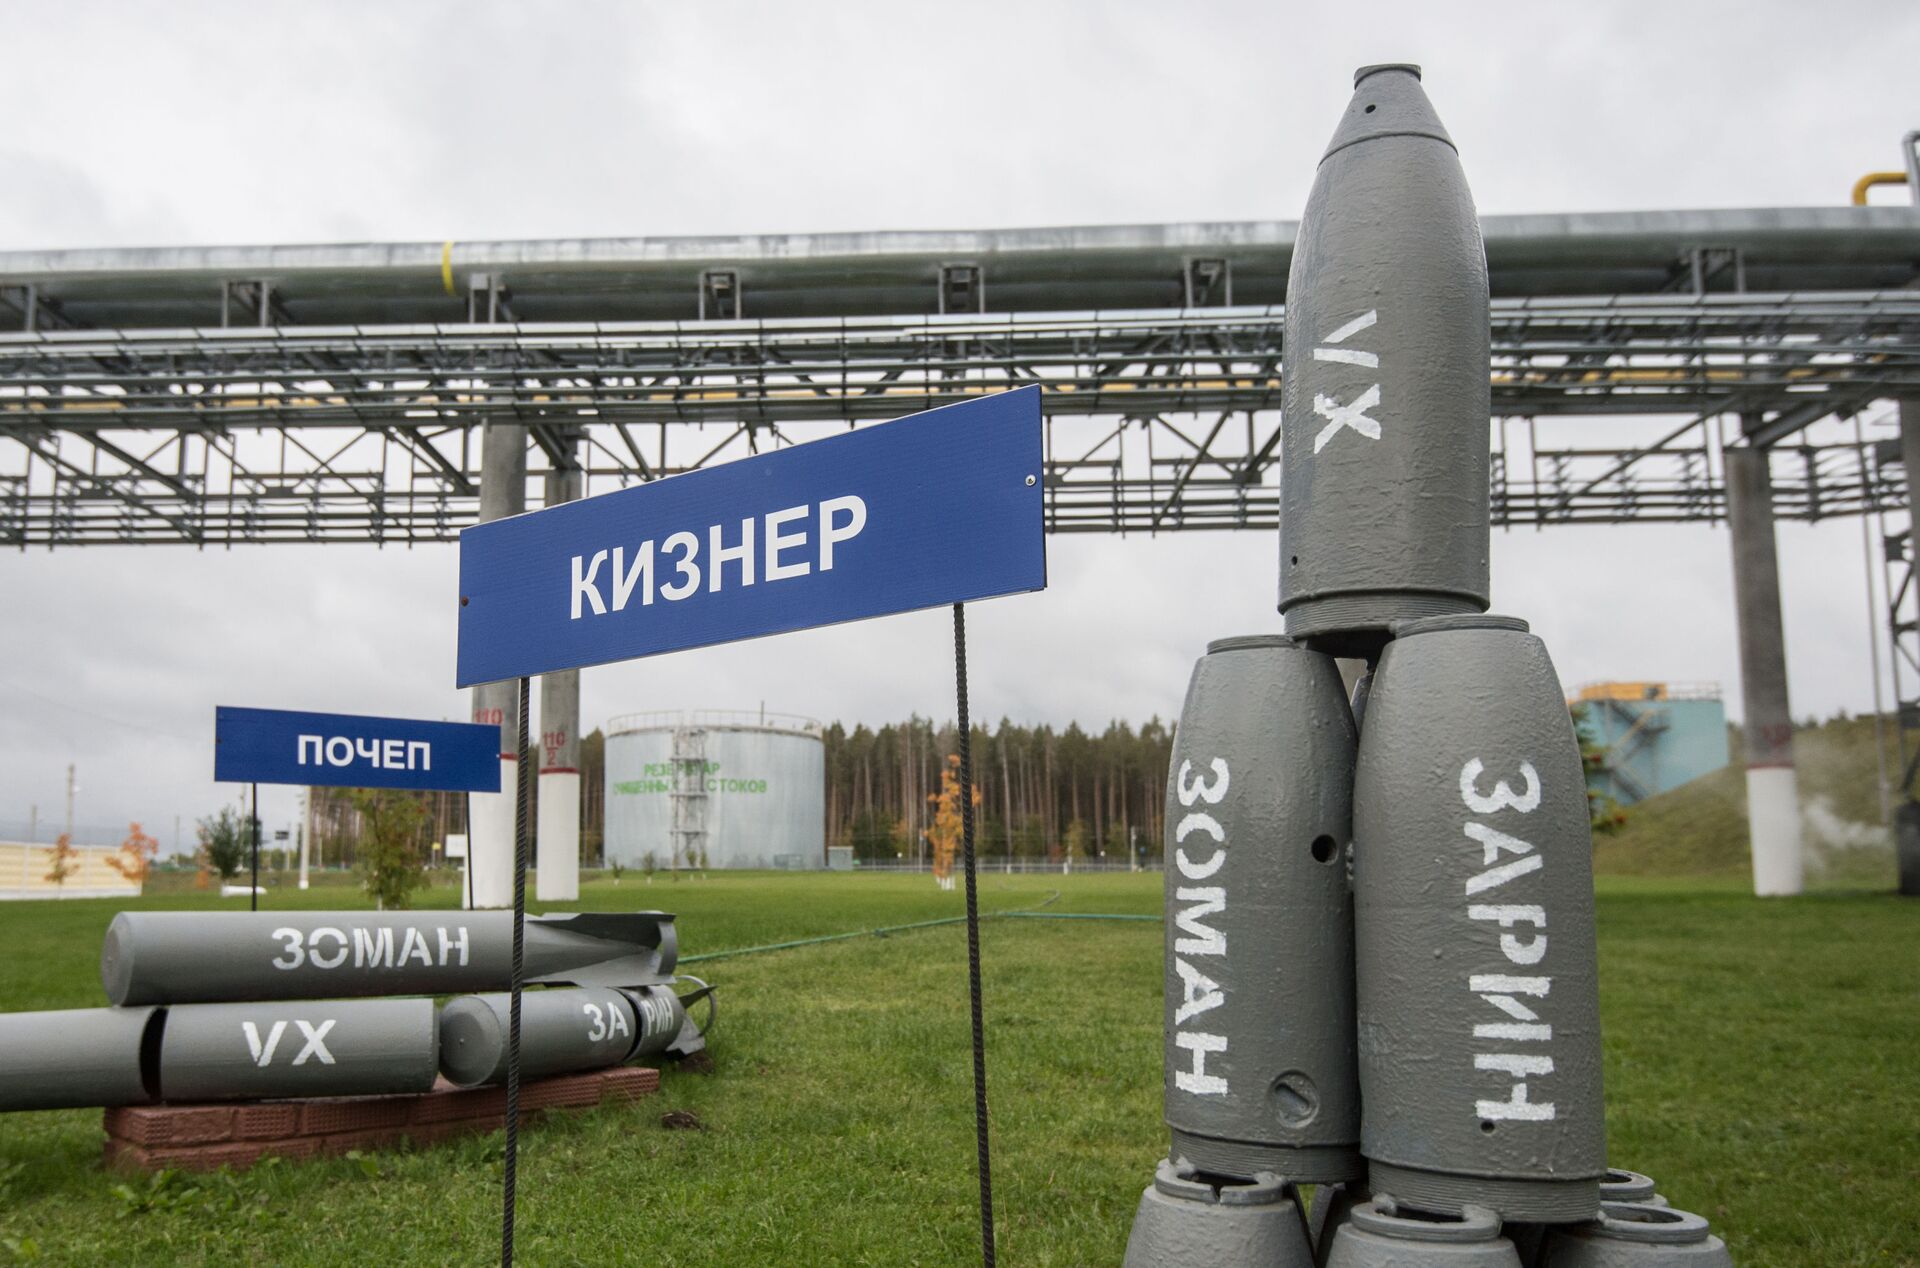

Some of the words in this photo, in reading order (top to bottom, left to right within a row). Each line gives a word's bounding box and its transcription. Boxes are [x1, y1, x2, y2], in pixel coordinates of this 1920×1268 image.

[1313, 309, 1382, 455] VX
[571, 495, 867, 620] КИЗНЕР
[297, 734, 431, 771] ПОЧЕП
[543, 731, 566, 747] 110
[706, 778, 768, 794] СТОКОВ
[271, 926, 470, 970] ЗОМАН
[1174, 756, 1231, 1098] ЗОМАН
[1458, 756, 1556, 1121] ЗАРИН
[242, 1018, 336, 1067] VX
